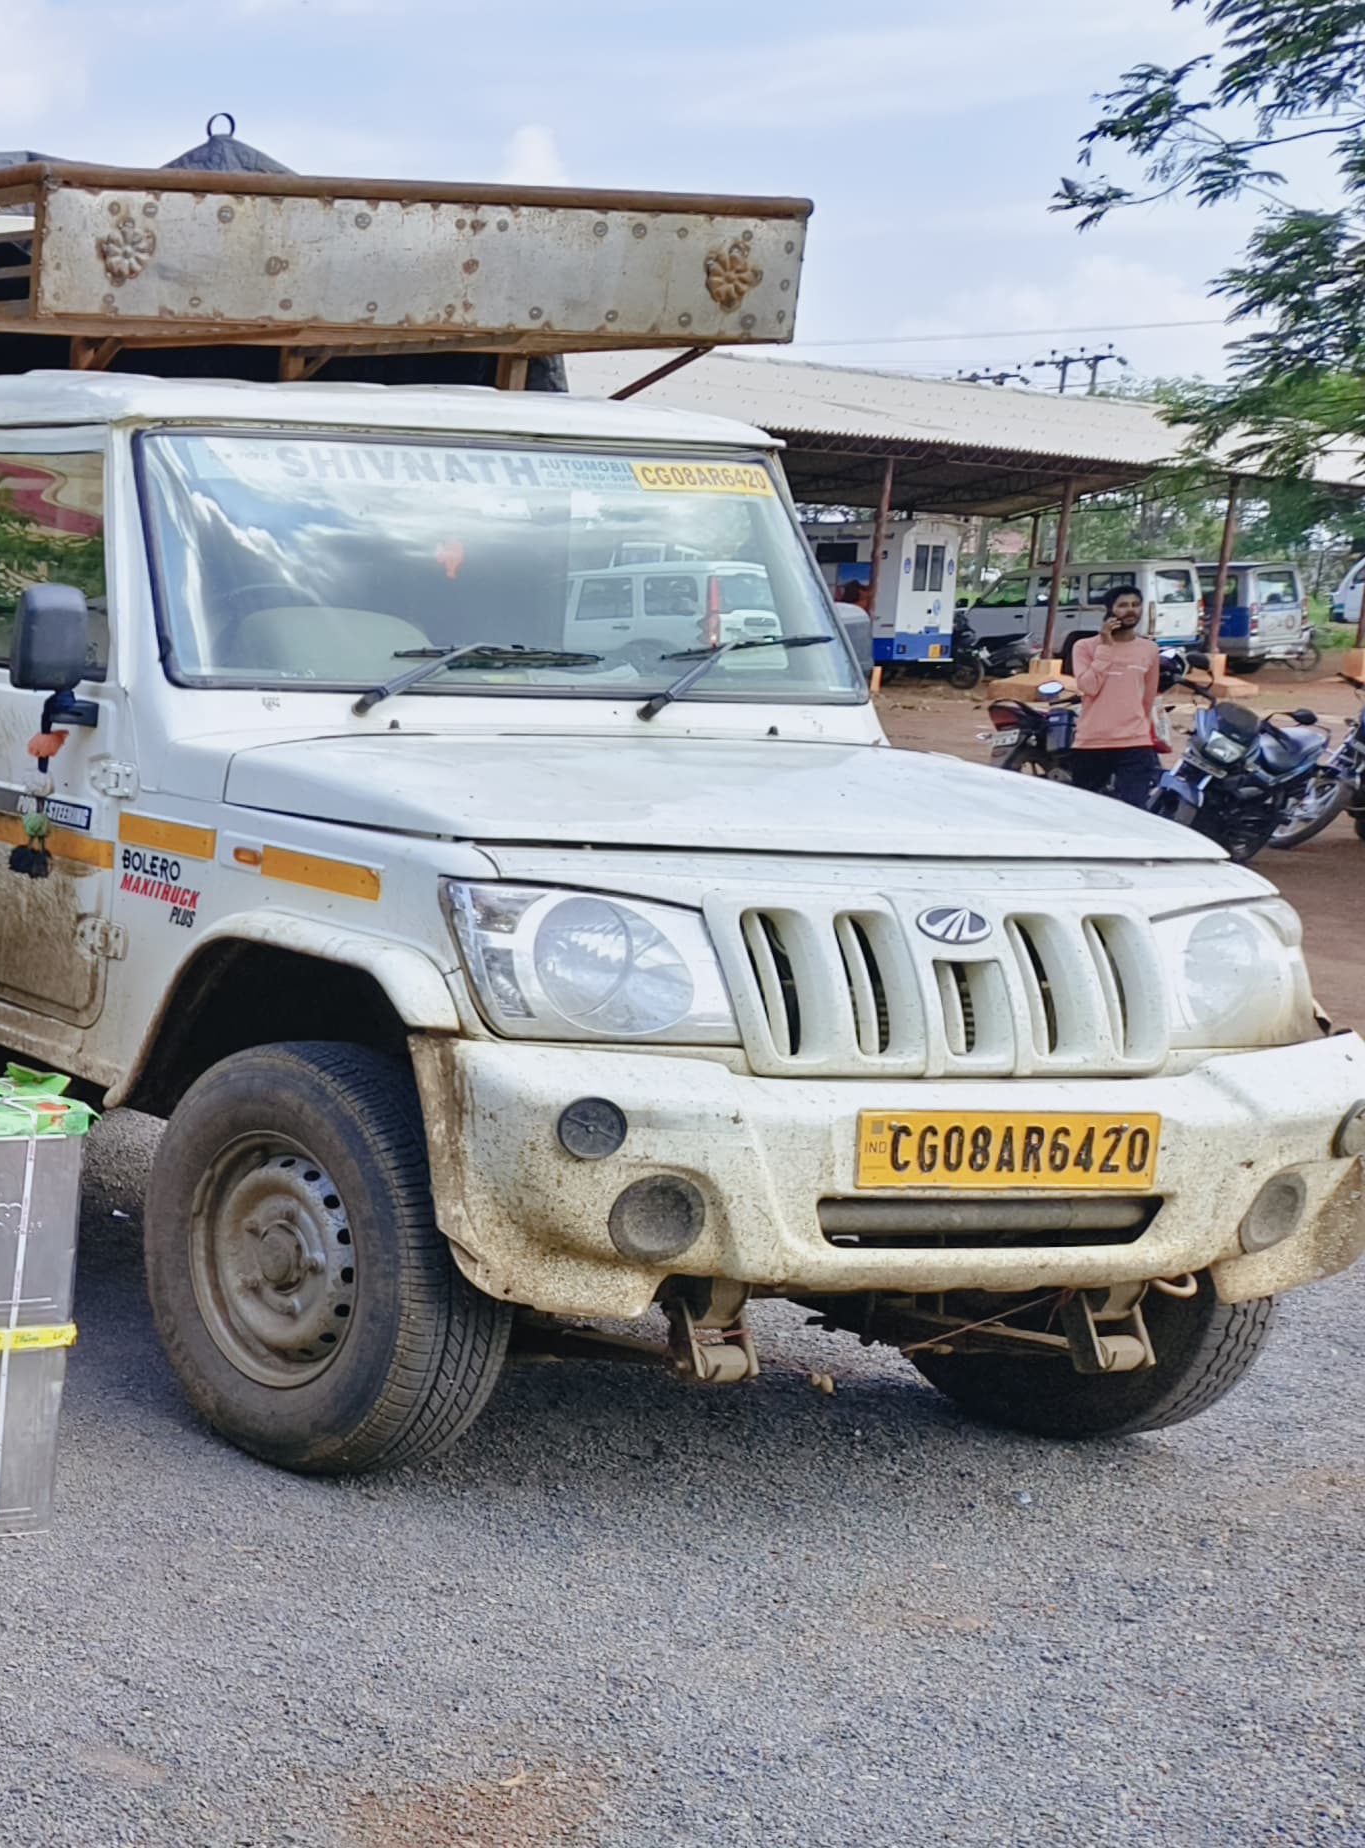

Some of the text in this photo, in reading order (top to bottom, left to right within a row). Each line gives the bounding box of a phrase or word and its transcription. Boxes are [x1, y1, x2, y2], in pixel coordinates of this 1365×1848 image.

[276, 446, 541, 487] SHIVNATH
[642, 466, 767, 490] CG08AR6420
[122, 848, 181, 882] BOLERO
[120, 872, 201, 909] MAXITRUCK
[169, 906, 196, 928] PLUS
[864, 1141, 887, 1155] IND
[890, 1125, 1150, 1173] CG08AR6420
